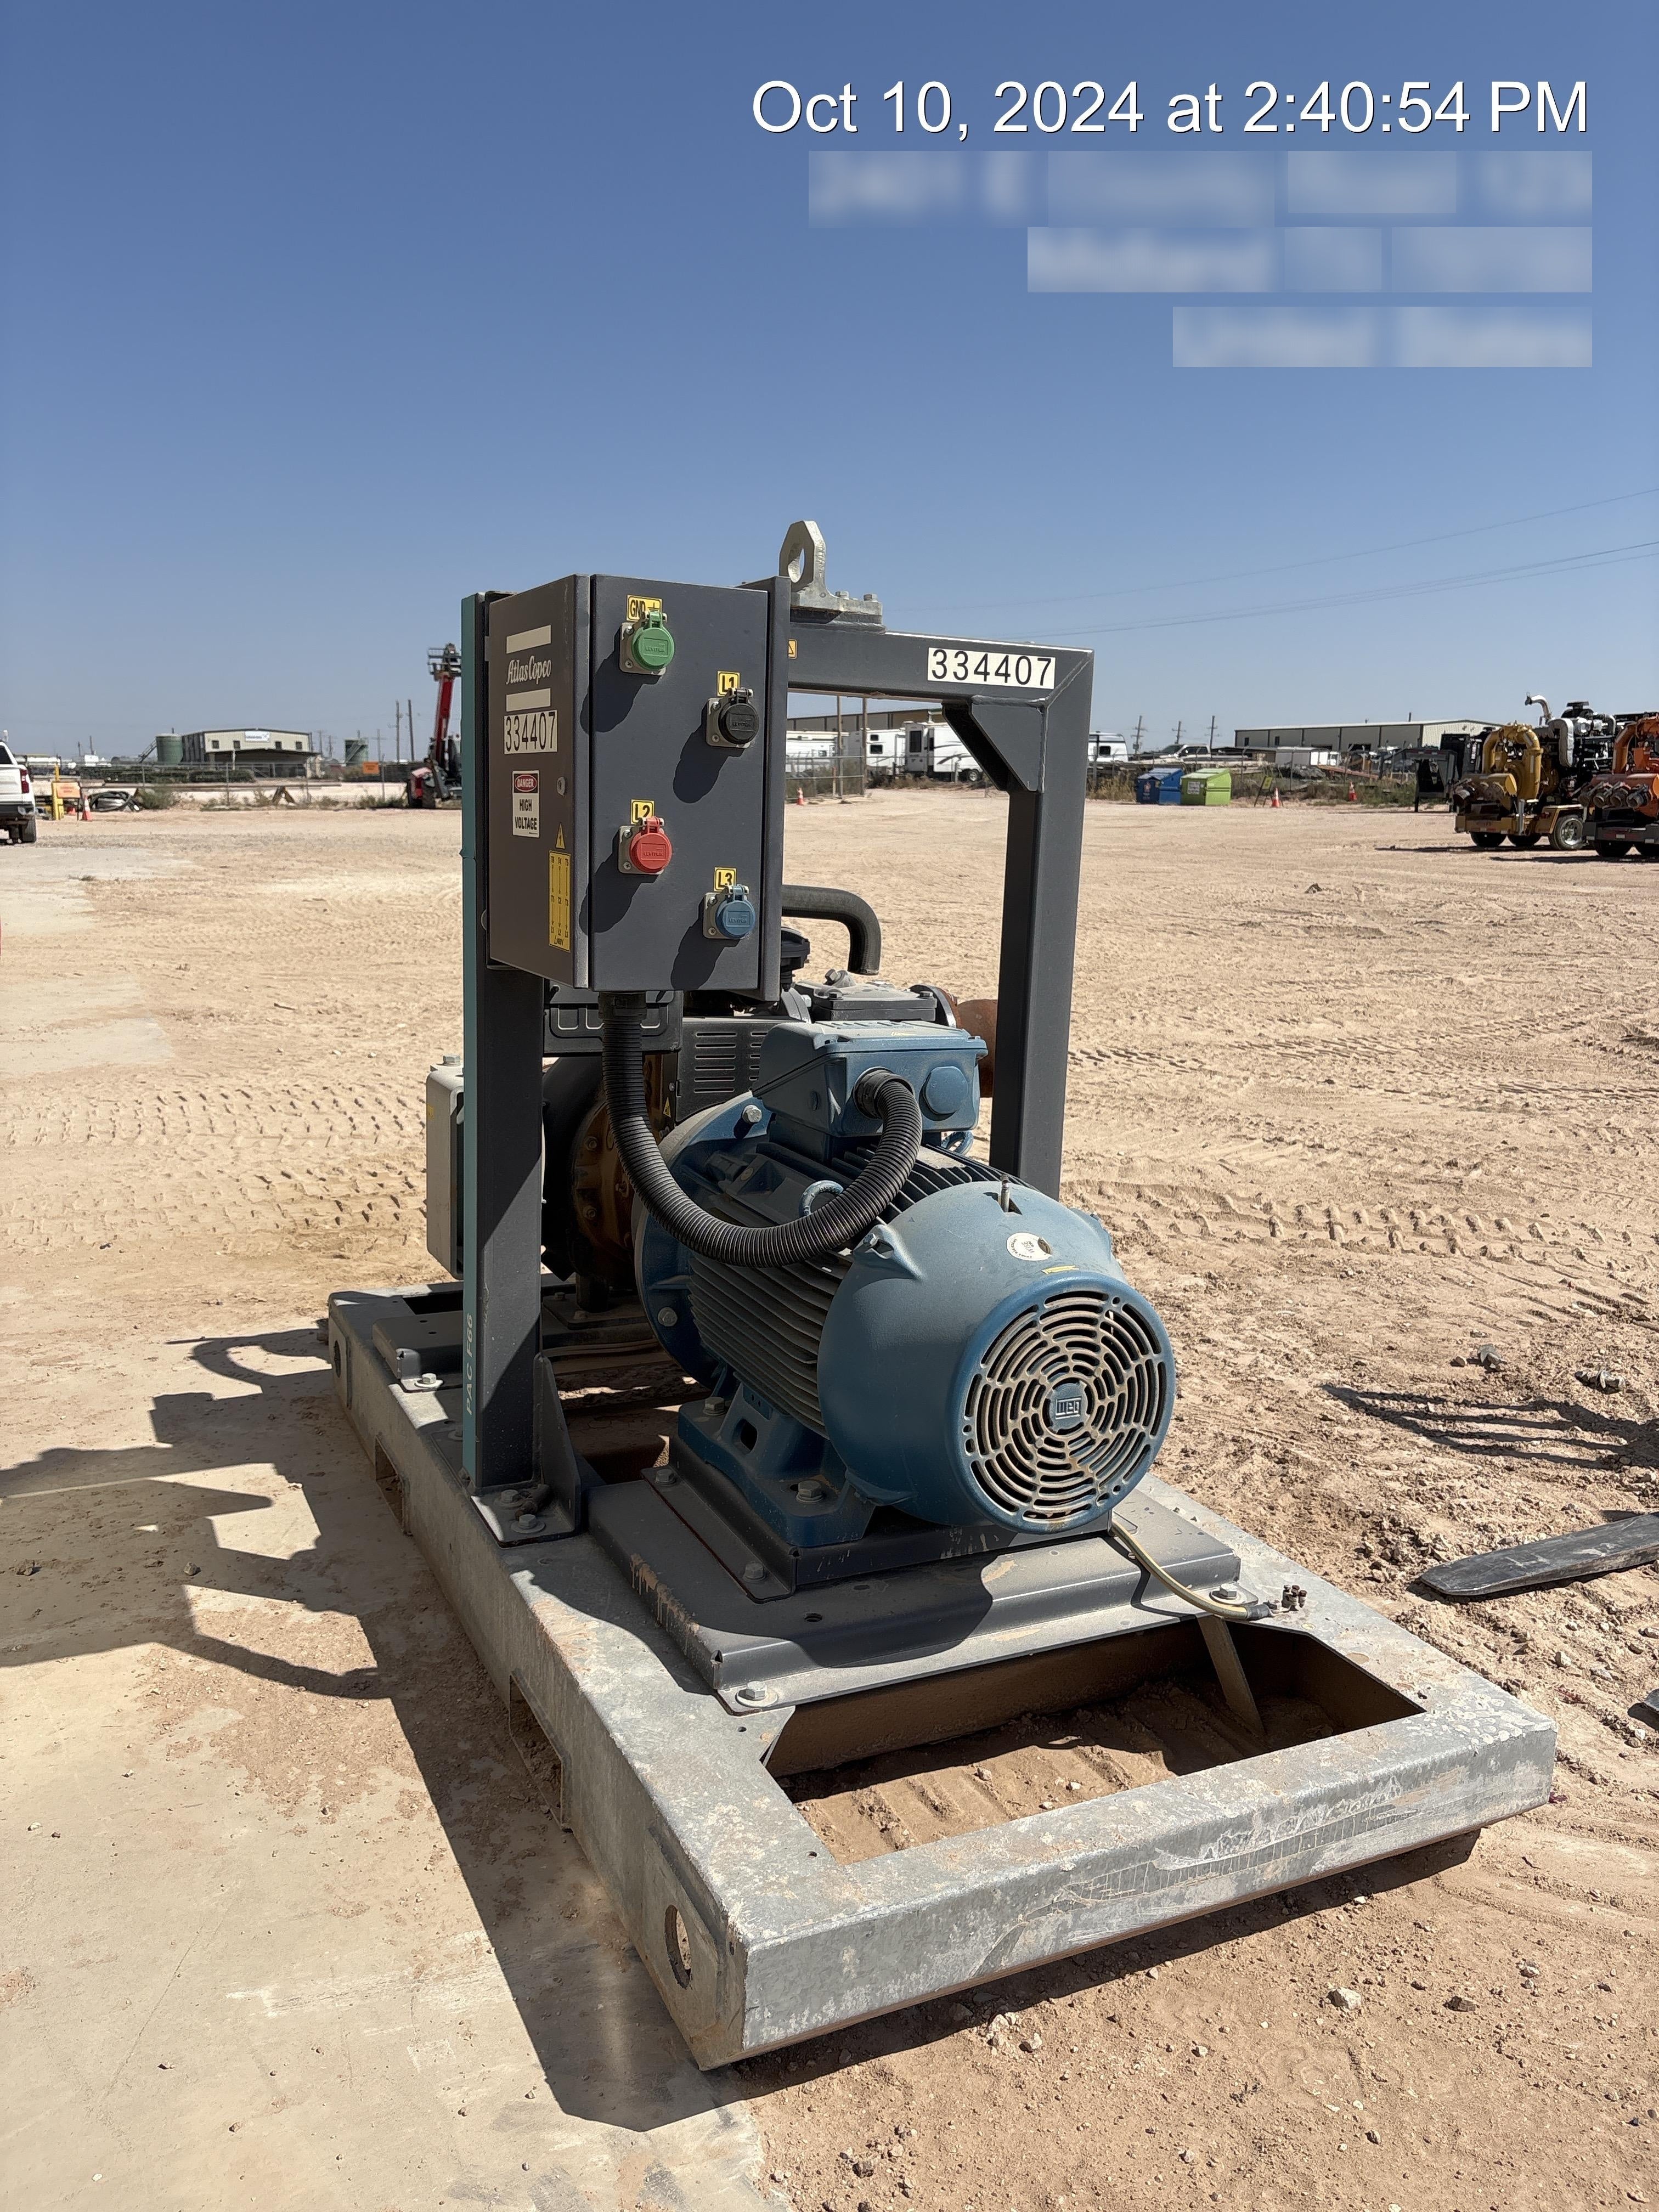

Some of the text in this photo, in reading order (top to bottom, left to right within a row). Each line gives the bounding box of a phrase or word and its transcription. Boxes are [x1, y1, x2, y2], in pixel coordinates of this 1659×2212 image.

[630, 599, 646, 618] GND
[932, 648, 1052, 686] 334407
[721, 675, 735, 693] L1
[505, 711, 556, 752] 334407
[516, 778, 534, 788] DANGER
[518, 799, 533, 812] HIGH
[634, 803, 651, 821] L2
[514, 816, 538, 831] VOLTAGE
[718, 871, 733, 888] L3
